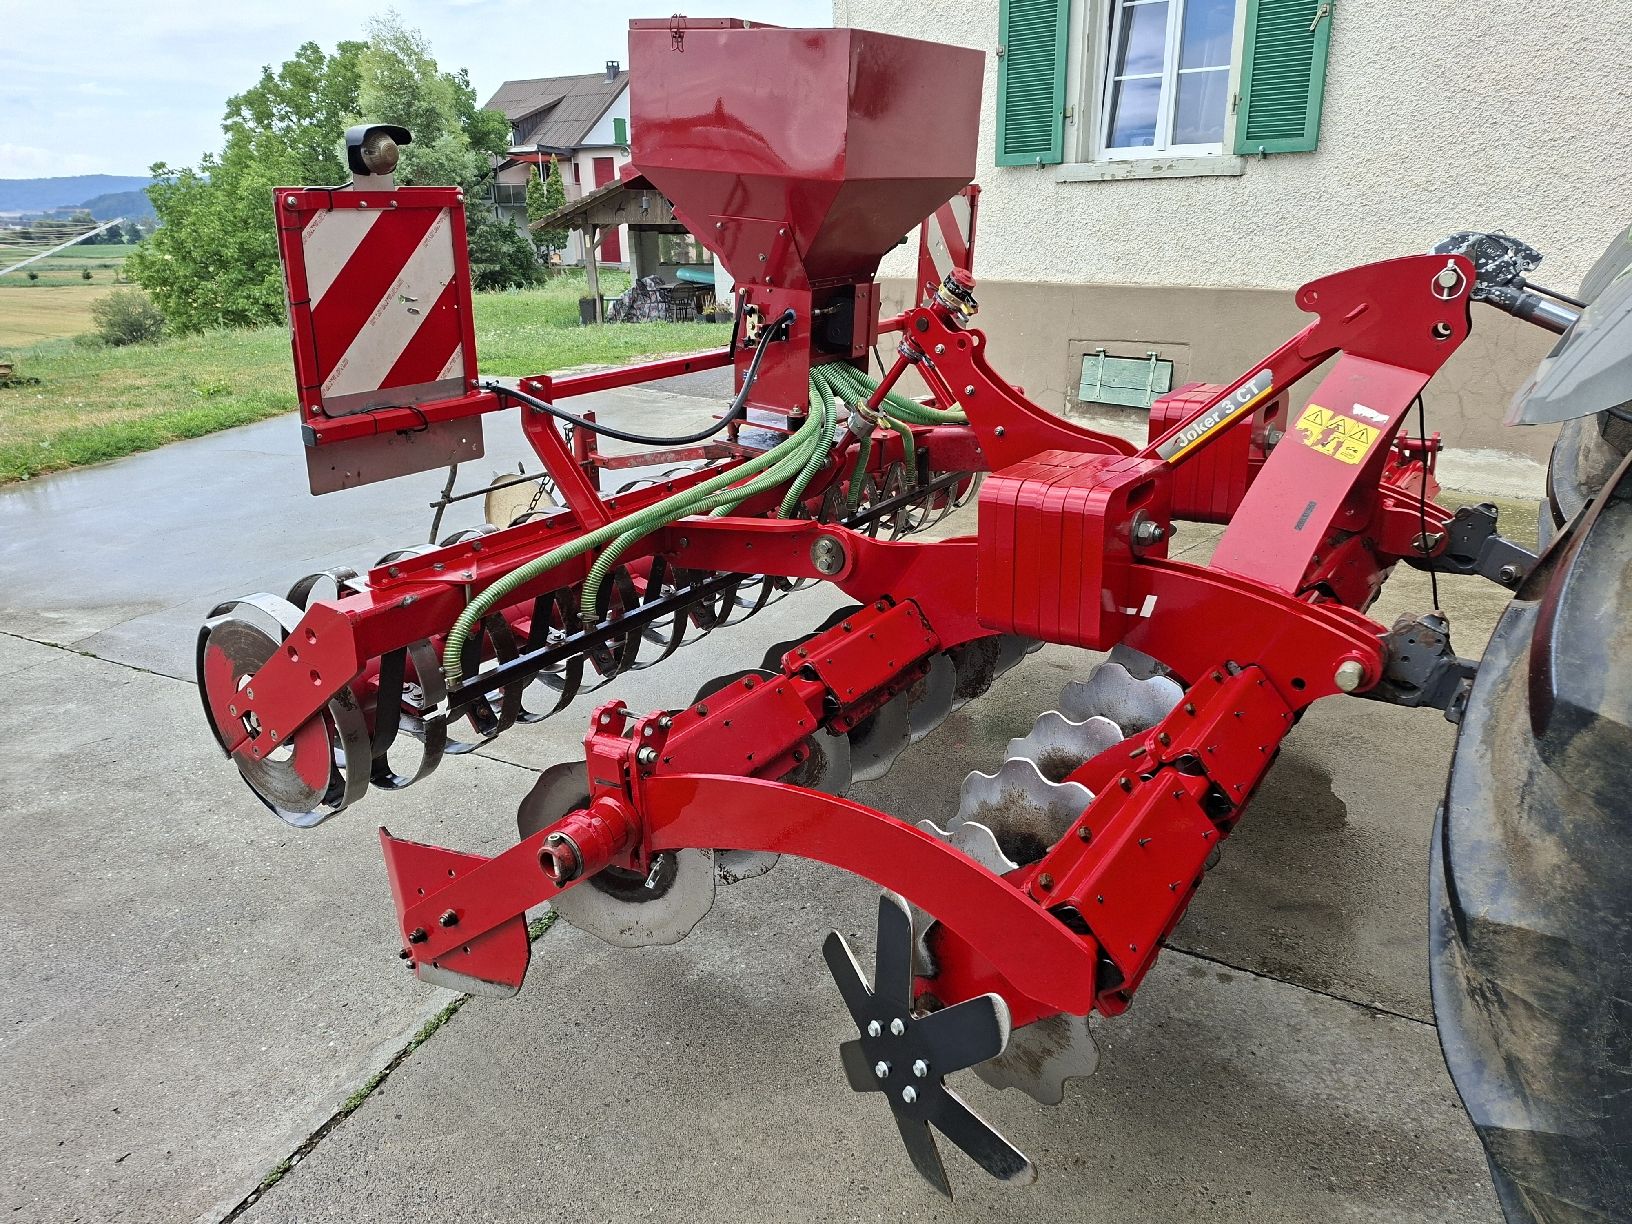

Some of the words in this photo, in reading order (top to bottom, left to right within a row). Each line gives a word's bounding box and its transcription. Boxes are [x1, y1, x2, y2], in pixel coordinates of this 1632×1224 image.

[1179, 411, 1221, 447] Joker
[1221, 400, 1236, 414] 3
[1236, 379, 1260, 403] CT
